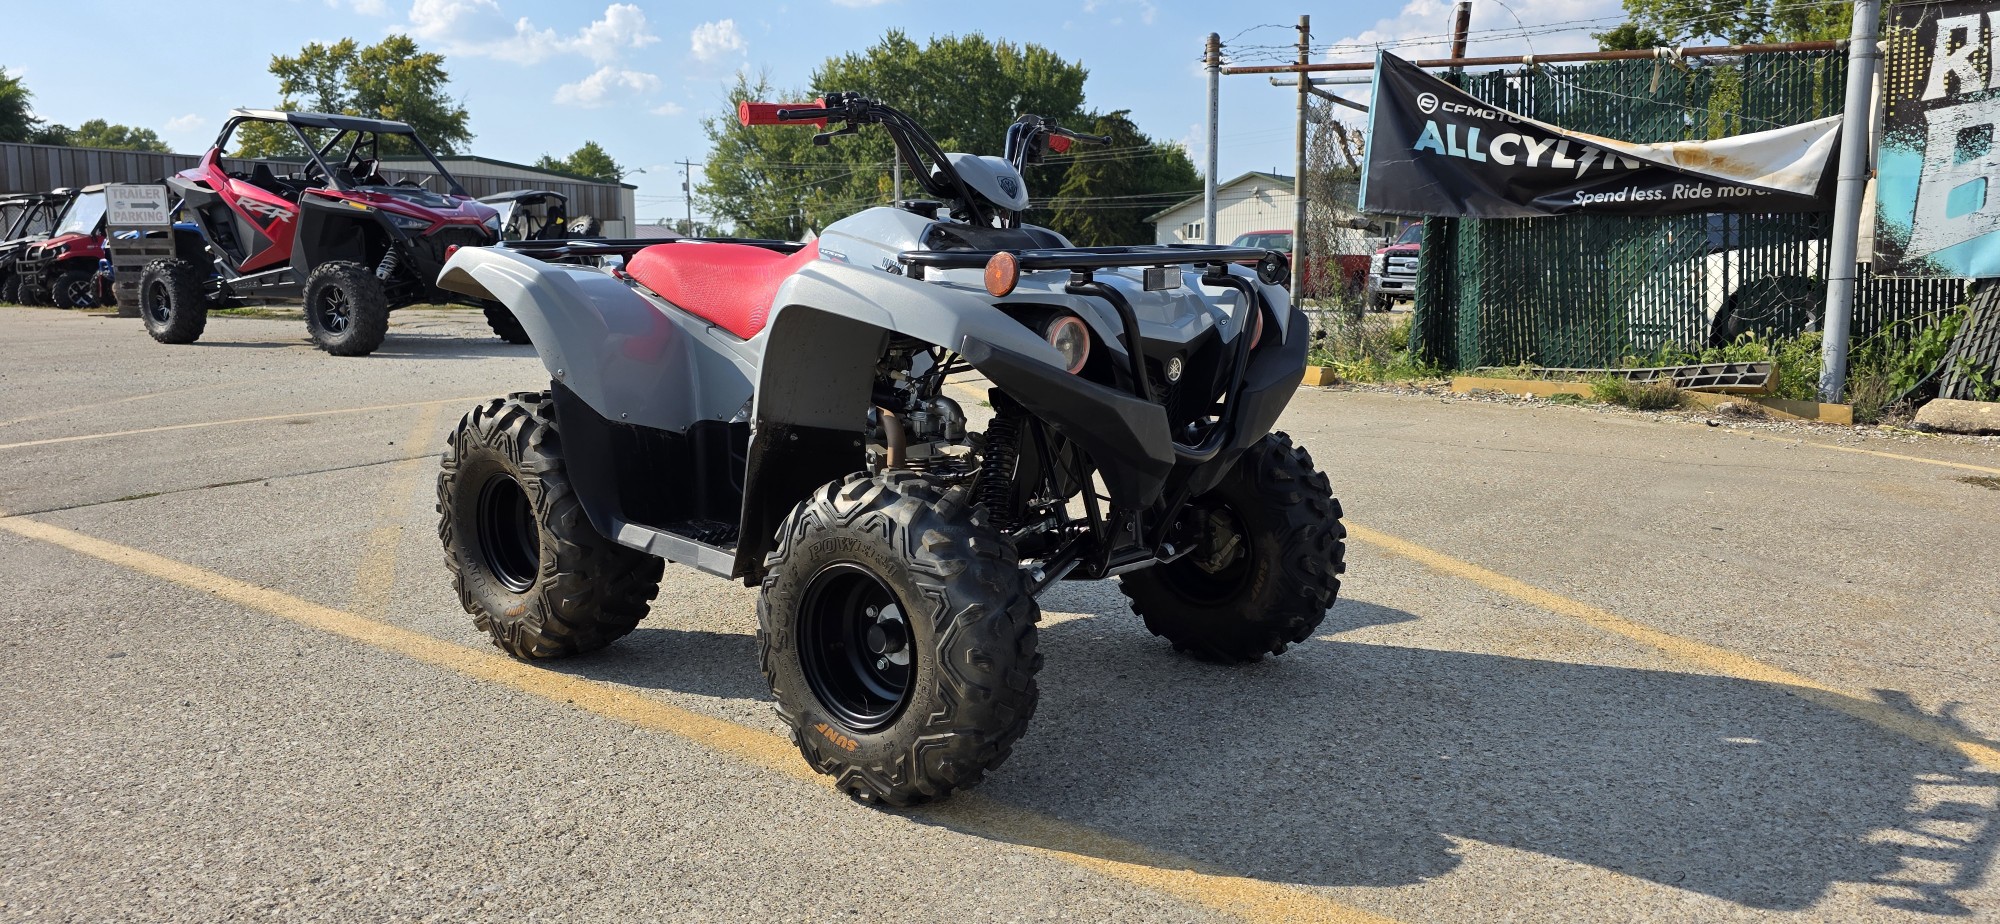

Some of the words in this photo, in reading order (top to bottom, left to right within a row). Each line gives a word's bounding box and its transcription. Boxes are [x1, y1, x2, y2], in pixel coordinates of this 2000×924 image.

[1441, 101, 1521, 125] CFMOTO
[112, 188, 160, 200] TRAILER
[1573, 186, 1629, 206] Spend
[1630, 185, 1667, 202] less.
[1672, 183, 1715, 200] Ride
[113, 211, 164, 222] PARKING
[236, 196, 295, 224] RZR
